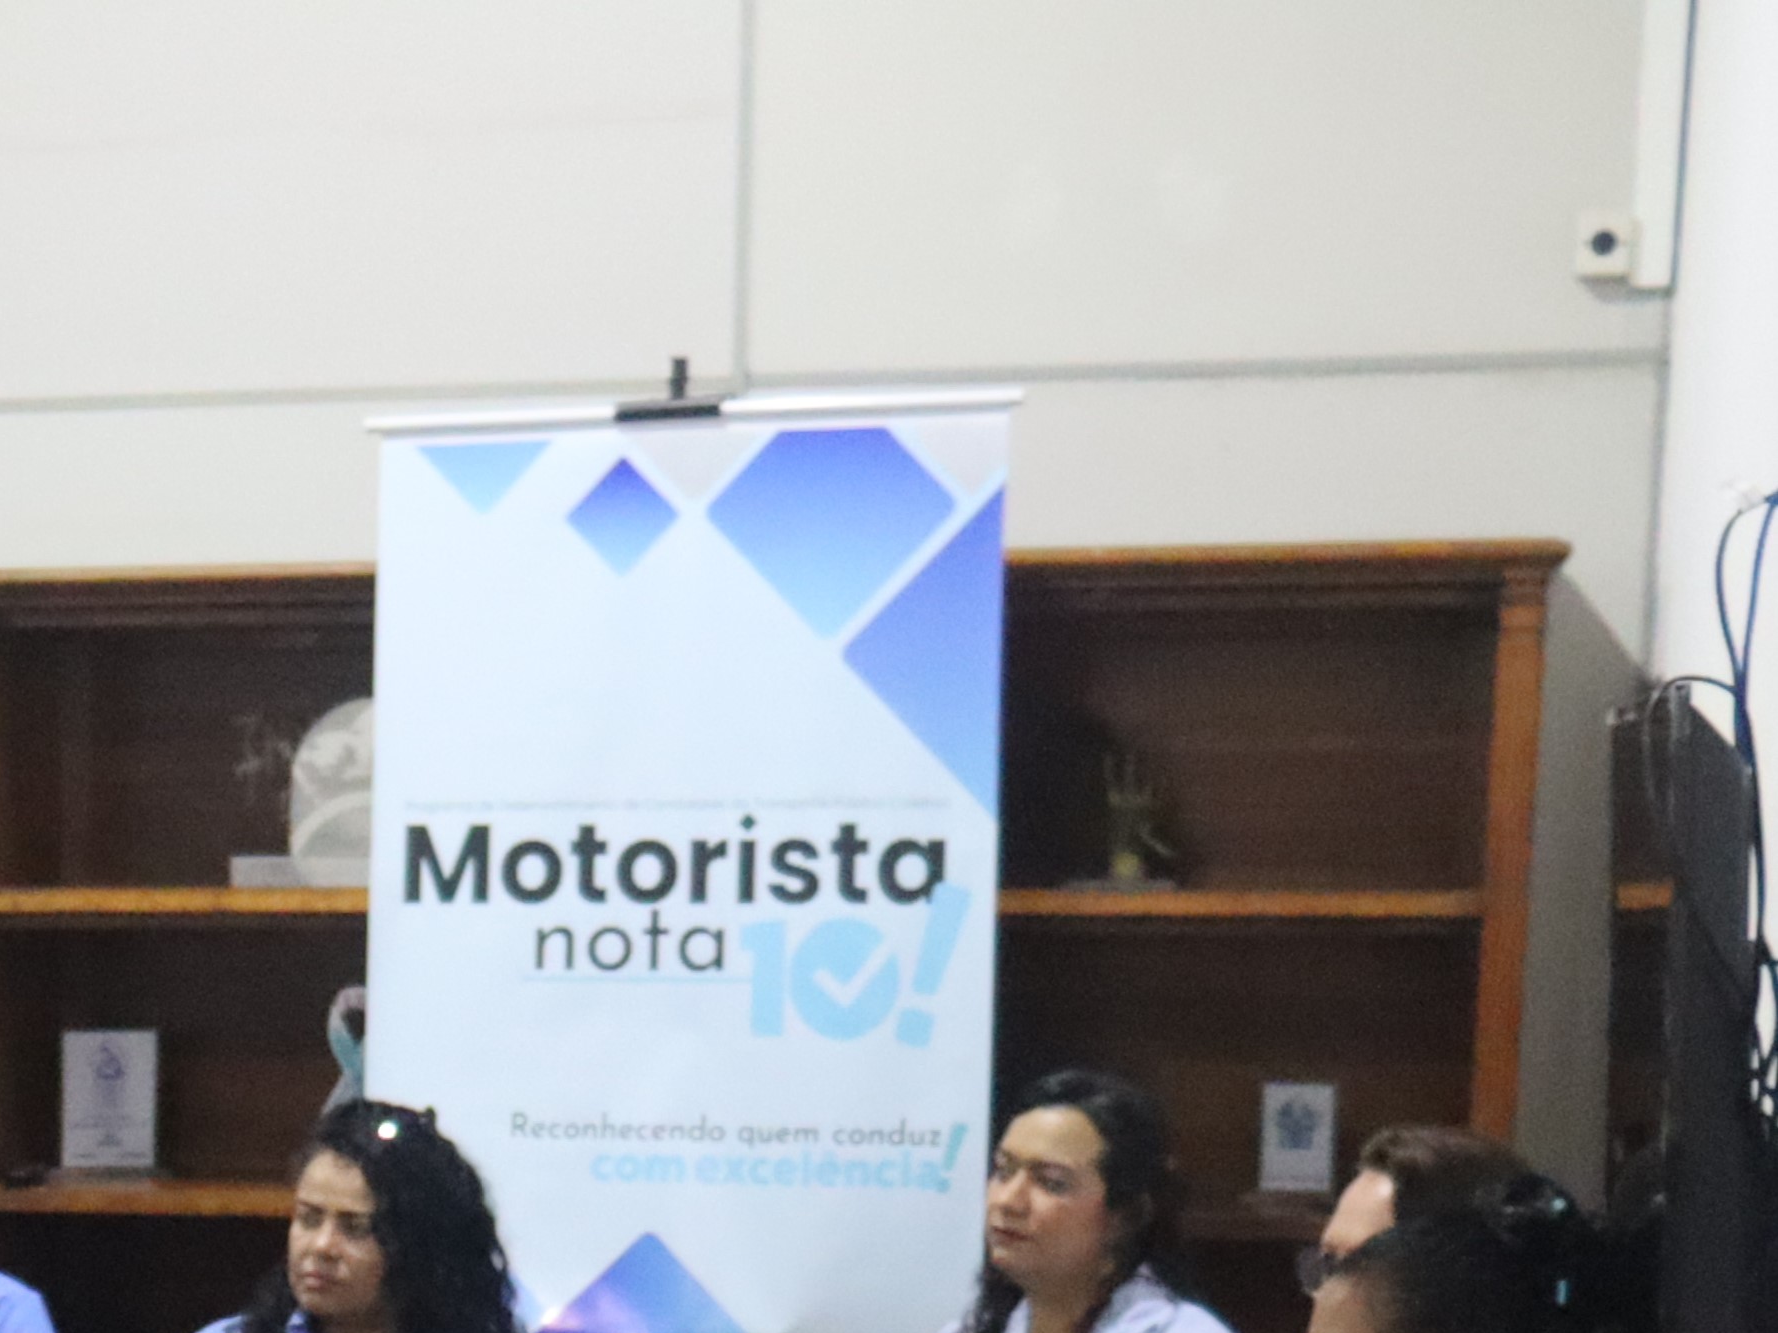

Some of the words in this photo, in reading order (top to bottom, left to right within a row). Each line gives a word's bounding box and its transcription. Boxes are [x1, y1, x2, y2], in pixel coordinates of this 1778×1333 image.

[403, 815, 948, 906] Motorista
[532, 908, 726, 973] nota
[509, 1112, 727, 1144] Reconhecendo
[736, 1122, 820, 1152] quem
[831, 1121, 942, 1149] conduz
[590, 1152, 686, 1184] com
